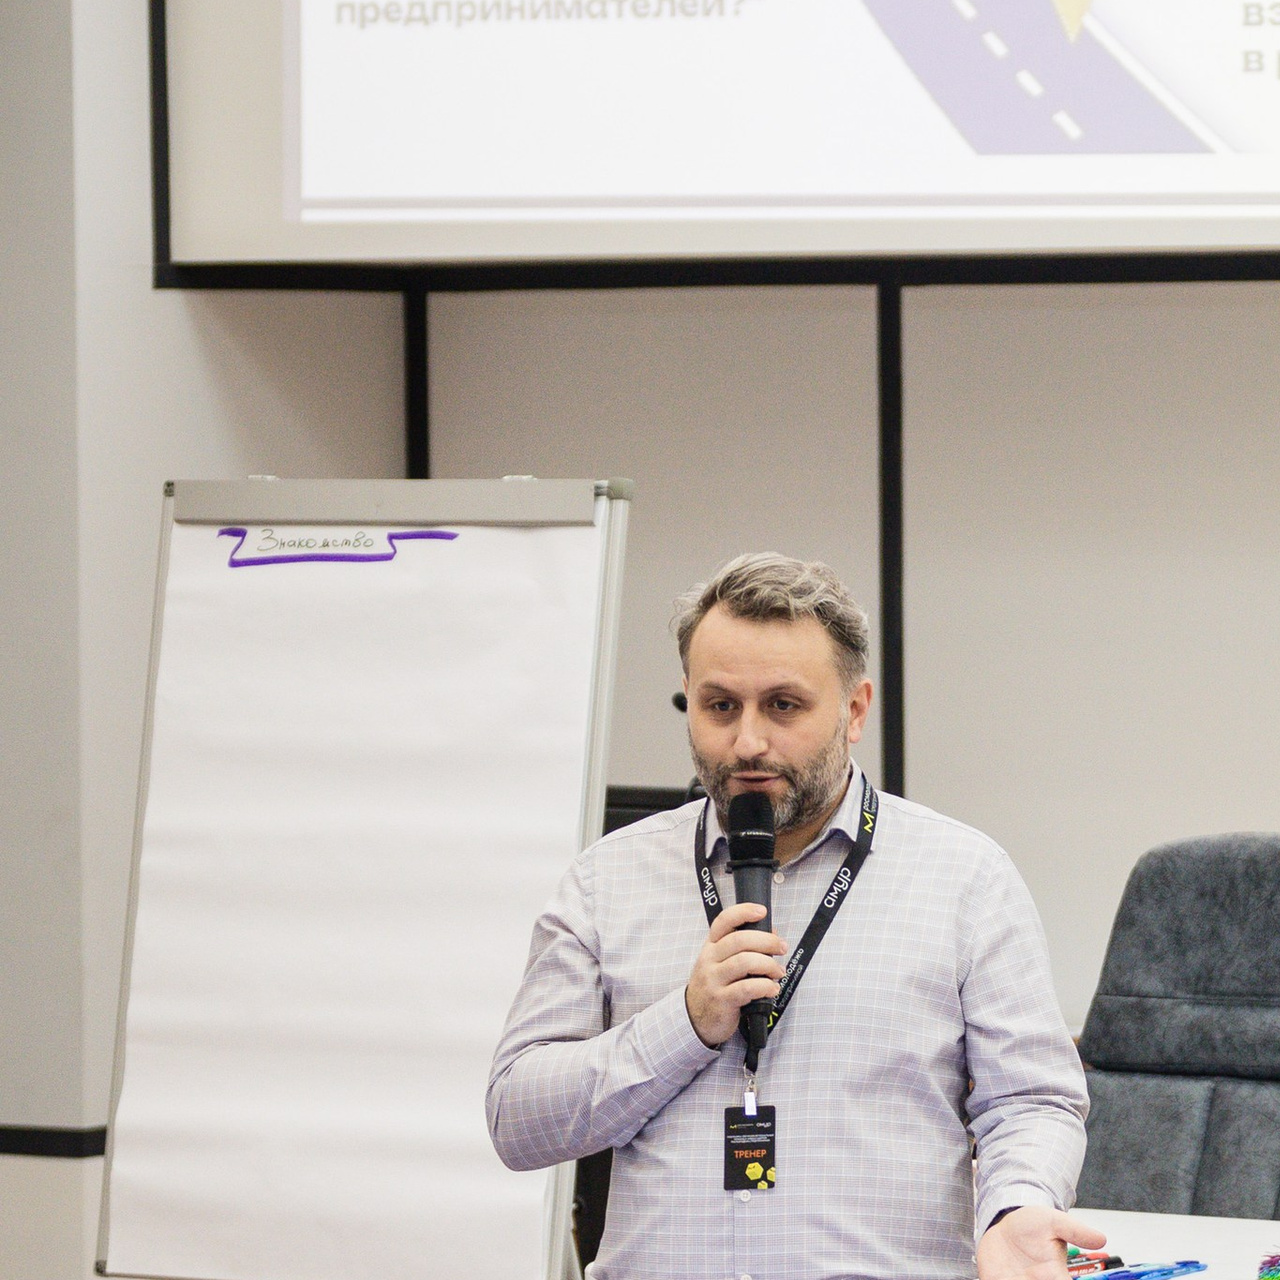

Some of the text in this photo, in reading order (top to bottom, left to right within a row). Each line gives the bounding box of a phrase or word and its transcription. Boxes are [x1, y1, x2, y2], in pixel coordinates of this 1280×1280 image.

[1241, 48, 1265, 74] в
[257, 528, 374, 552] Знакомство
[701, 867, 718, 906] амур
[823, 867, 852, 908] амур
[734, 1149, 767, 1158] ТРЕНЕР
